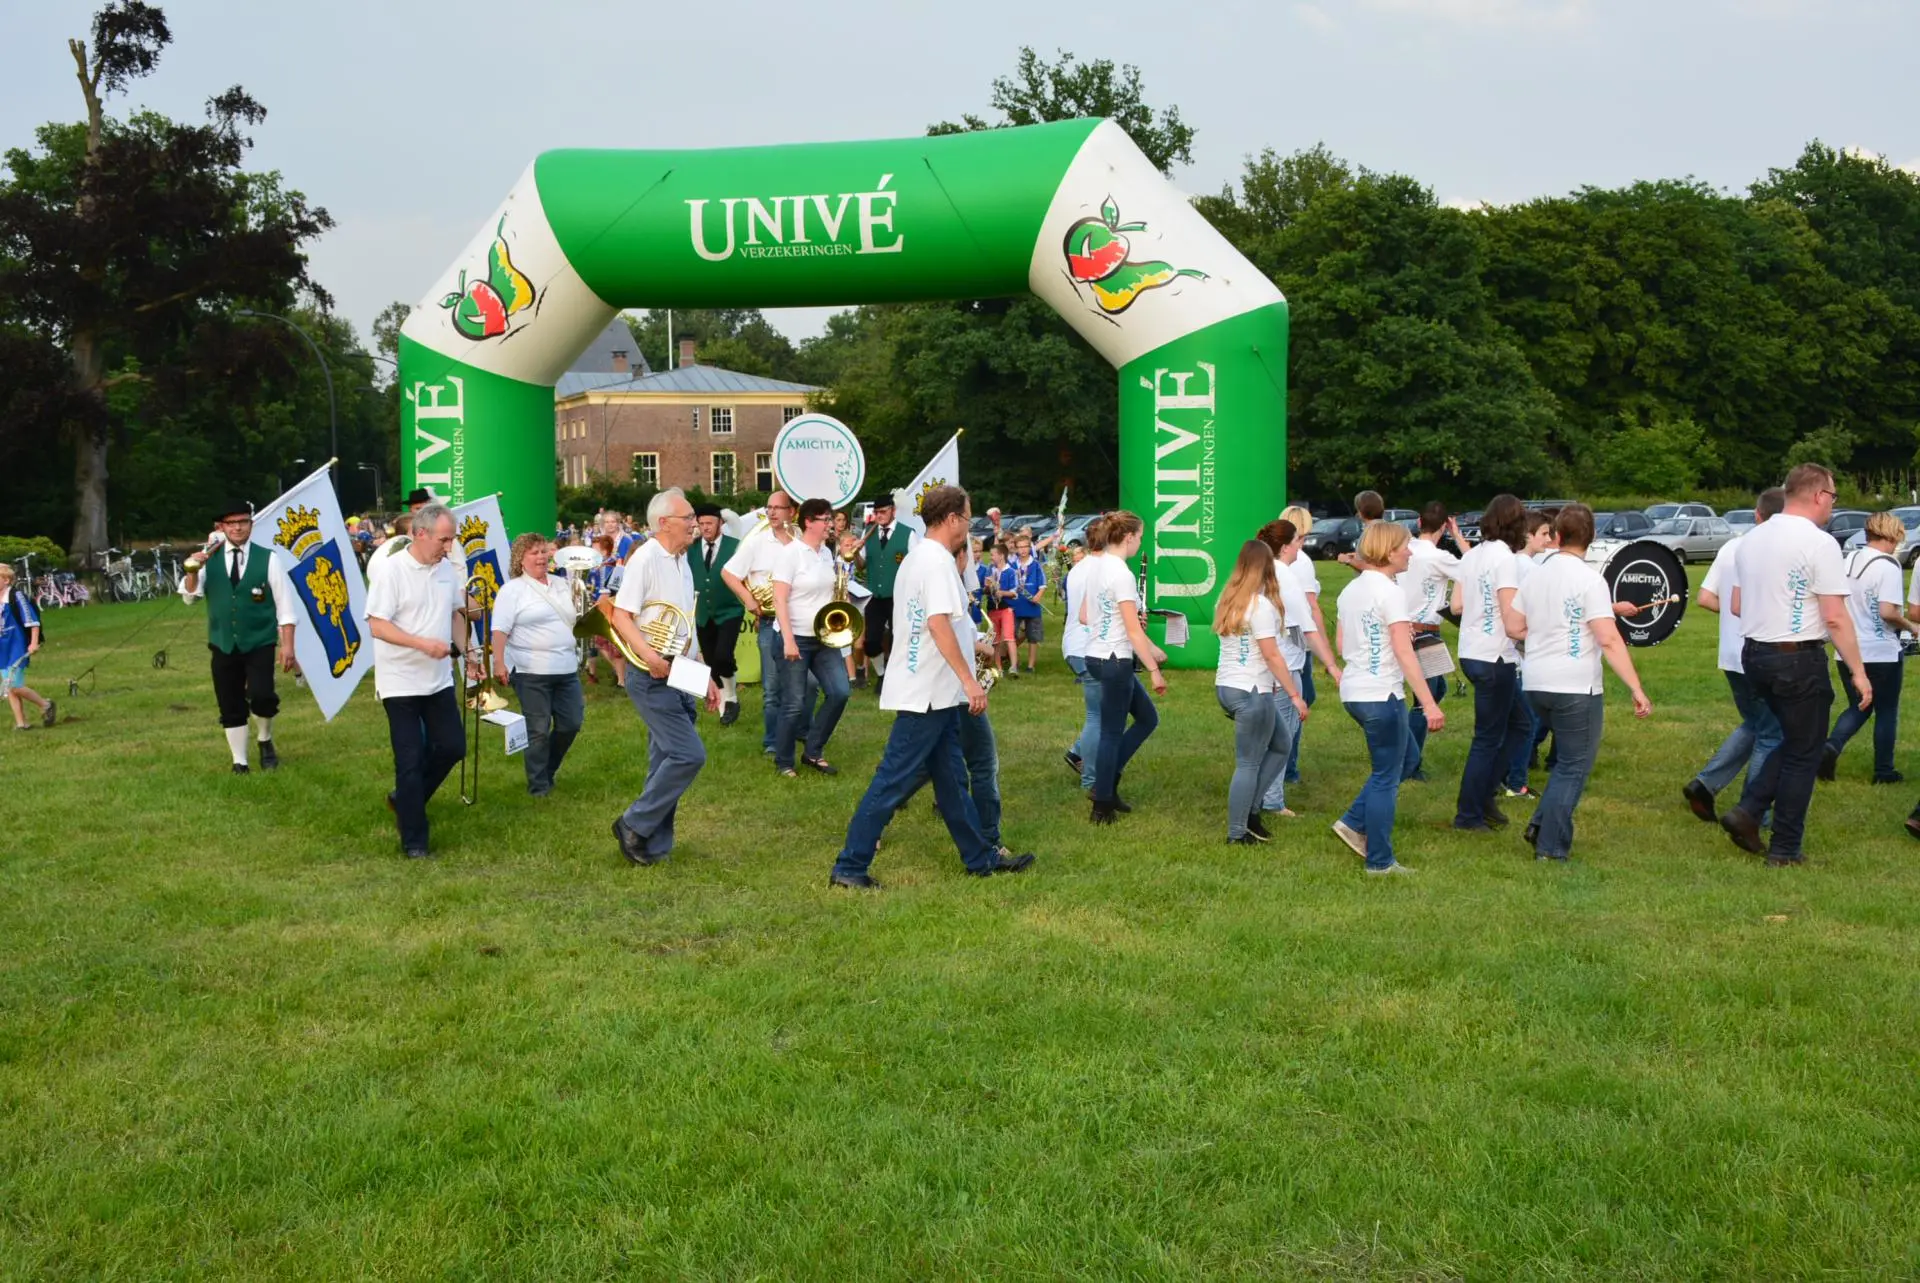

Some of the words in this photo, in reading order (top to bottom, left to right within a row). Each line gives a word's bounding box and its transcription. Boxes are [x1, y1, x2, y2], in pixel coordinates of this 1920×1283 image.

[684, 173, 904, 262] UNIVÉ
[740, 244, 853, 259] VERZEKERINGEN
[406, 375, 465, 505] IVÉ
[453, 428, 465, 505] EKERINGEN
[786, 439, 845, 450] AMICITIA
[1140, 361, 1217, 604] UNIVÉ
[1202, 419, 1216, 545] VERZEKERINGEN
[1484, 583, 1494, 636] AMICITIA
[1621, 575, 1662, 584] AMICITIA
[1791, 579, 1808, 634] AMICITIA
[907, 608, 924, 674] AMICITIA
[1369, 622, 1381, 676] AMICITIA
